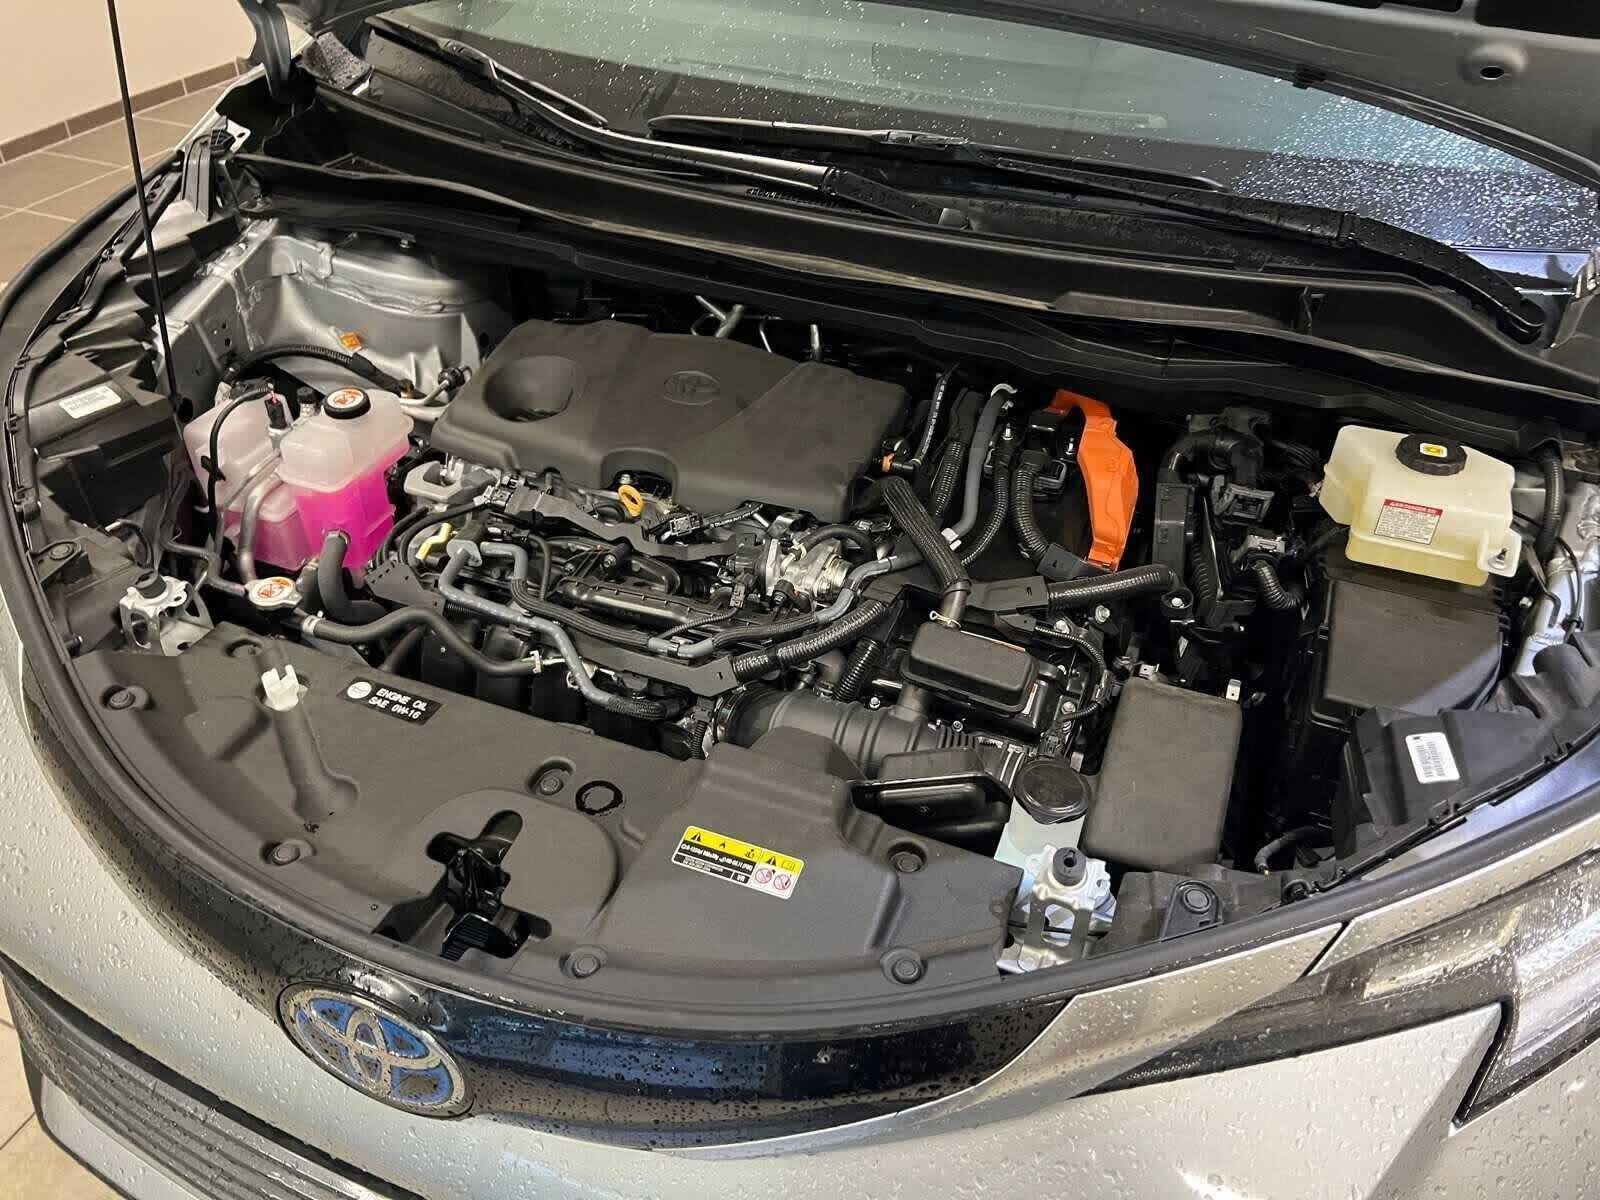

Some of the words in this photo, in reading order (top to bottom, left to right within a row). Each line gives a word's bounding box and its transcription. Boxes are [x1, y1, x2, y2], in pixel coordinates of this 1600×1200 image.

[368, 697, 390, 708] SAE
[391, 704, 422, 719] 0W-16
[376, 688, 411, 705] ENGINE
[413, 700, 428, 711] OIL
